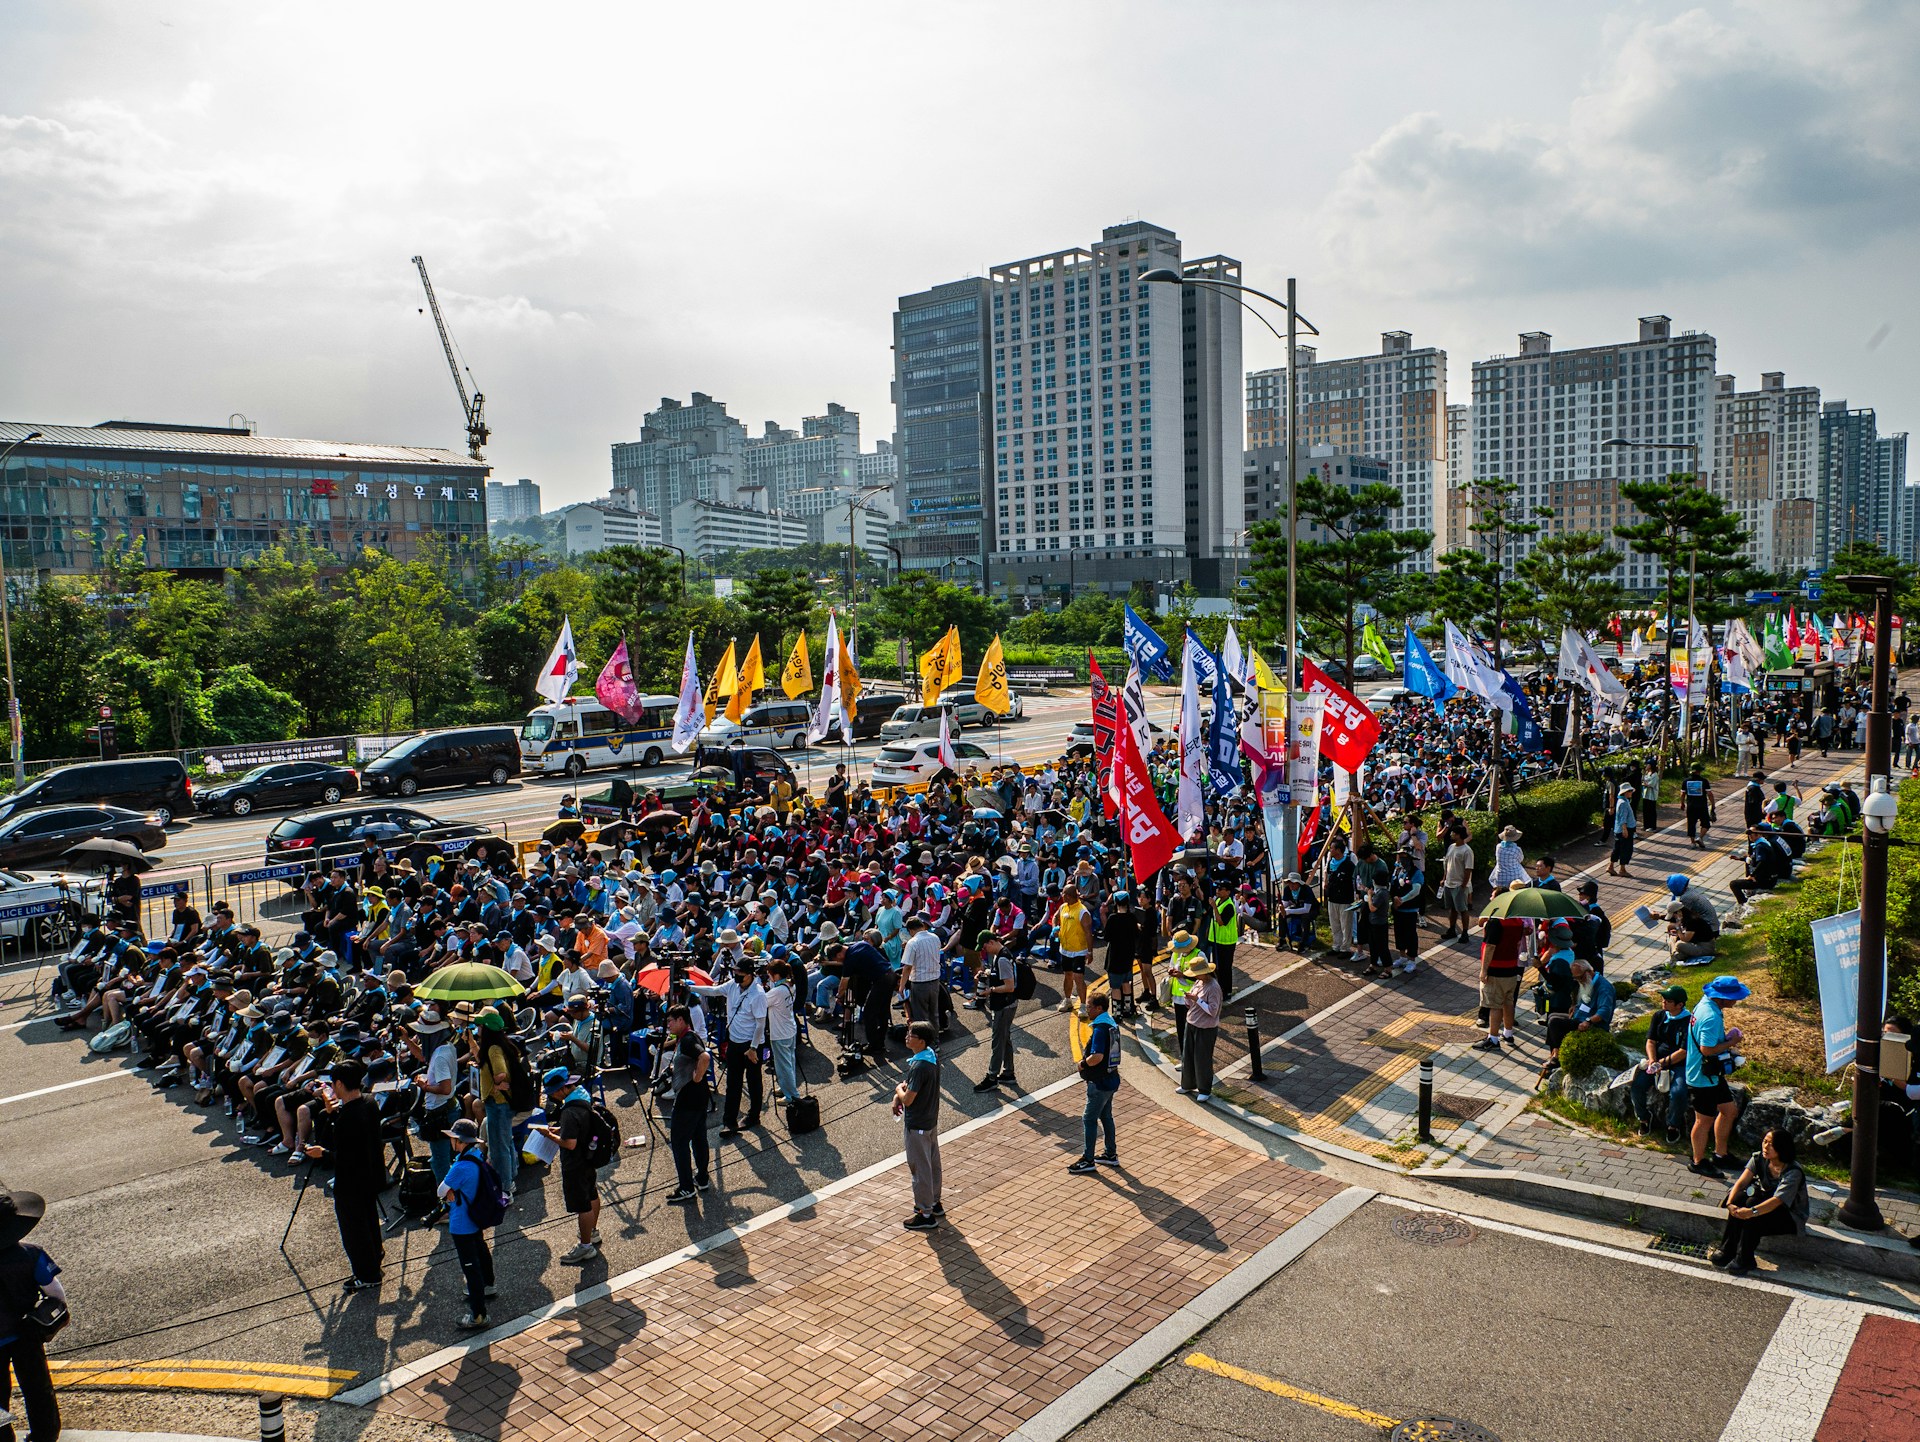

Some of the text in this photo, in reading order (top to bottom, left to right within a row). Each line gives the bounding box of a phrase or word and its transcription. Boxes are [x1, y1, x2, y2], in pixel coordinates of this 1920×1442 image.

[354, 482, 479, 501] 화성우체국
[444, 841, 468, 851] POLICE
[242, 866, 288, 881] POLICE LINE
[155, 884, 175, 894] LINE
[0, 903, 46, 919] OLICE LINE
